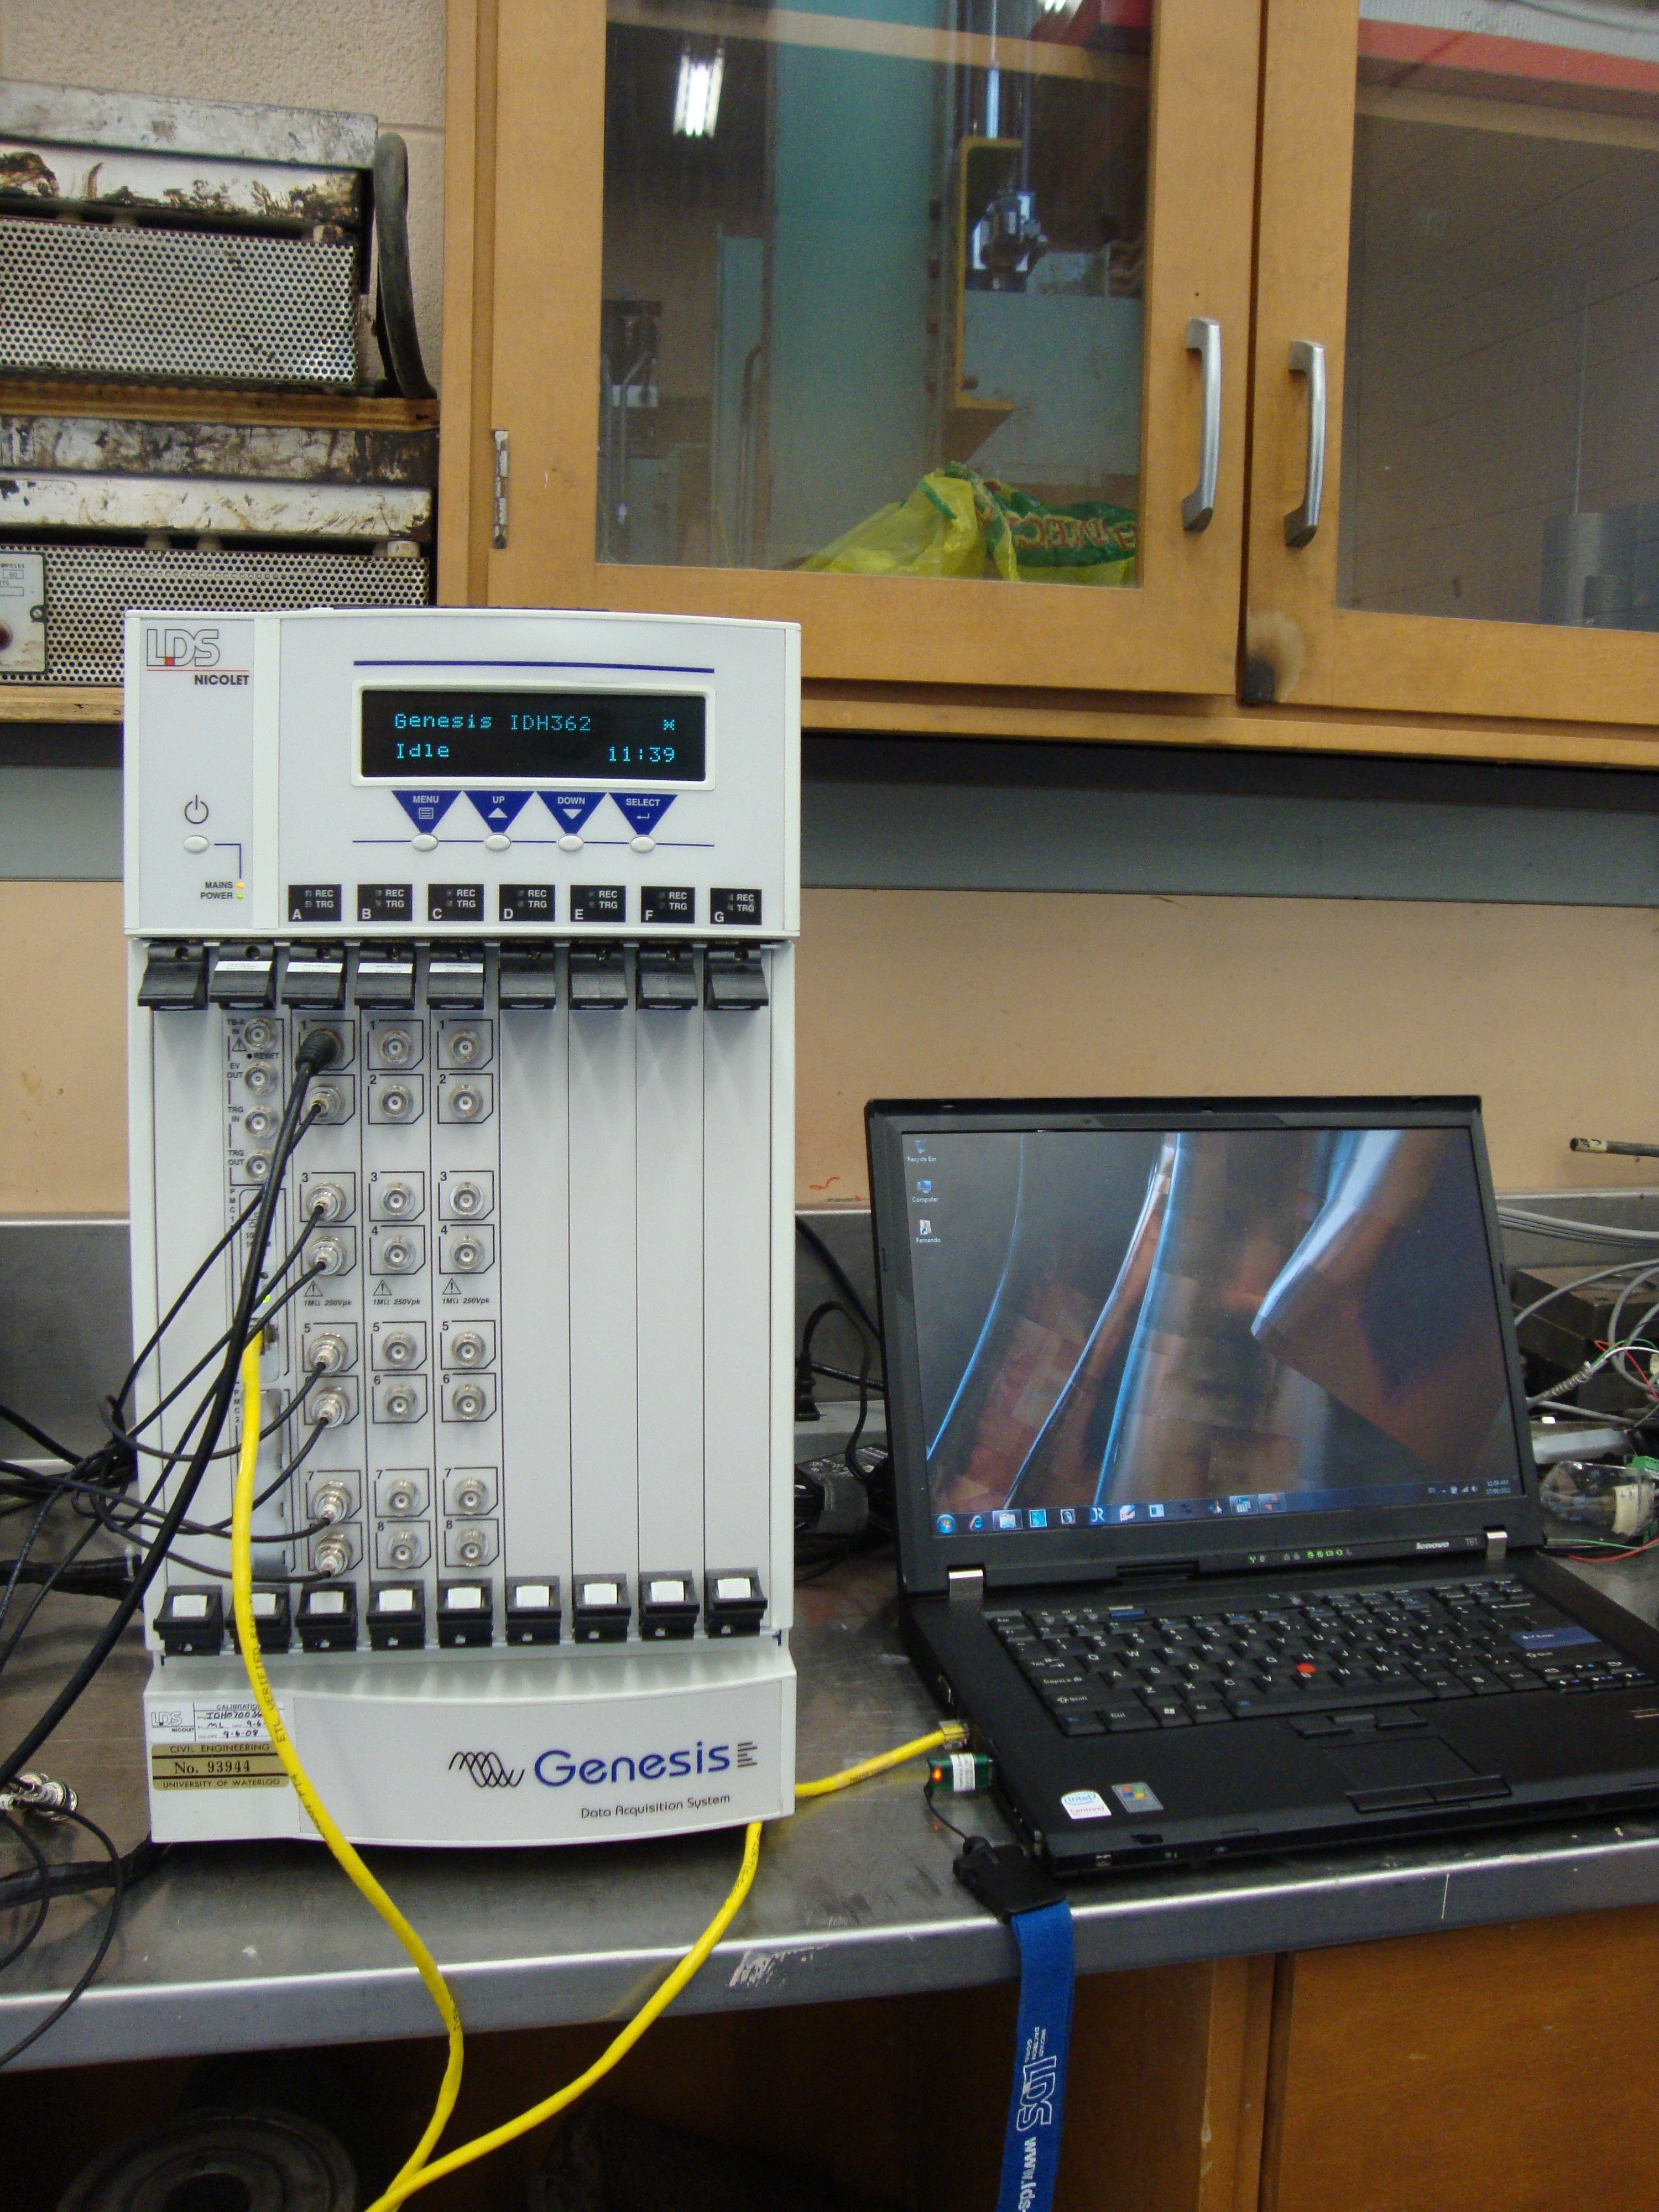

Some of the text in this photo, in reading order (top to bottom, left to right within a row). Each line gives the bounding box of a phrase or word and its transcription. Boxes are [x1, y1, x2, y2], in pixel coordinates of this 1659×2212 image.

[147, 629, 220, 667] LDS
[194, 674, 249, 686] NICOLET
[395, 713, 591, 731] Genesis IDH362
[397, 743, 676, 763] Idle 11:39
[413, 795, 440, 804] MENU
[492, 796, 505, 804] UP
[557, 796, 586, 805] DOWN
[625, 798, 661, 807] SELECT
[669, 891, 687, 900] REC
[737, 893, 754, 902] REC
[316, 900, 334, 909] TRG
[457, 900, 476, 909] TRG
[528, 900, 547, 909] TRG
[669, 902, 688, 910] TRG
[737, 904, 755, 912] TRG
[293, 909, 302, 920] A
[362, 909, 372, 920] B
[432, 909, 442, 920] C
[504, 909, 513, 920] D
[575, 909, 584, 920] E
[645, 910, 654, 921] F
[714, 911, 724, 922] G
[302, 1021, 307, 1030] 1
[370, 1021, 375, 1030] 1
[440, 1020, 445, 1029] 1
[369, 1075, 377, 1084] 2
[439, 1074, 446, 1084] 2
[301, 1173, 309, 1182] 3
[371, 1173, 378, 1182] 3
[440, 1172, 447, 1181] 3
[372, 1226, 379, 1235] 4
[441, 1225, 448, 1234] 4
[325, 1298, 352, 1307] 250Vpk
[463, 1297, 490, 1305] 250Vpk
[304, 1323, 311, 1333] 5
[373, 1322, 379, 1332] 5
[442, 1322, 449, 1331] 5
[374, 1376, 380, 1385] 6
[443, 1375, 450, 1384] 6
[307, 1471, 314, 1480] 7
[376, 1470, 383, 1479] 7
[445, 1469, 451, 1478] 7
[377, 1521, 384, 1531] 8
[446, 1520, 453, 1529] 8
[1416, 1541, 1449, 1550] lenovo
[151, 1711, 182, 1728] LDS
[170, 1744, 270, 1754] CIVIL ENGINEERING
[174, 1760, 251, 1775] No. 93944
[534, 1740, 731, 1787] Genesis
[163, 1780, 212, 1788] UNIVERSITY
[581, 1793, 731, 1819] Data Acquisition System
[1016, 2055, 1057, 2132] LDS
